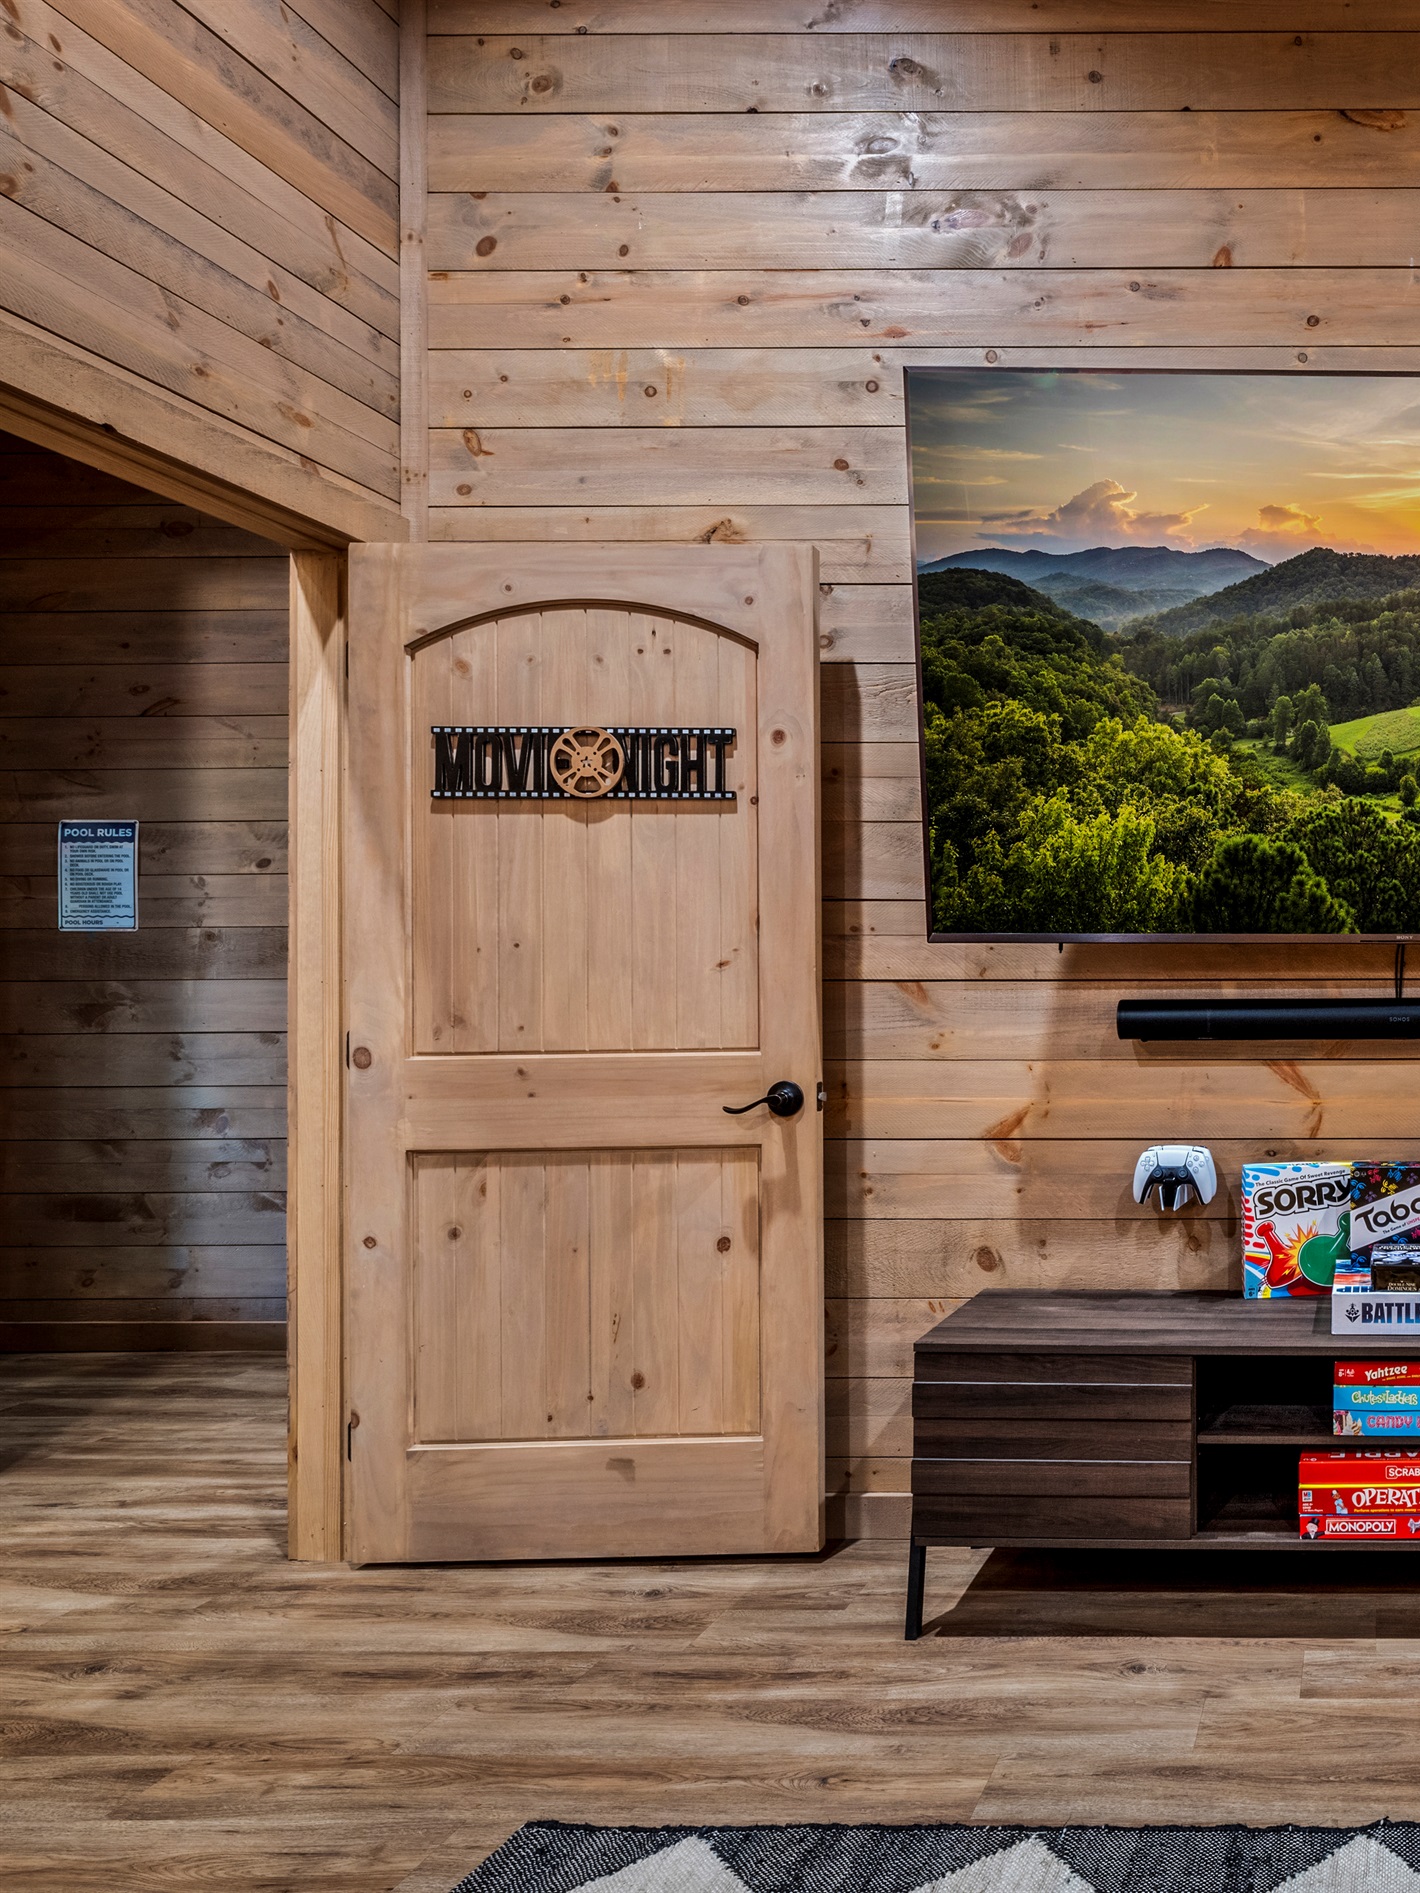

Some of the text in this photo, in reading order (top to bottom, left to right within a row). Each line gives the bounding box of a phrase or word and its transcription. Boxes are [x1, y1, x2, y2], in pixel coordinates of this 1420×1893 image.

[612, 732, 733, 792] NIGHT
[64, 828, 133, 837] POOL RULES
[1265, 1178, 1283, 1186] Classic
[1323, 1169, 1346, 1177] Revenge
[1364, 1365, 1408, 1381] Yahtzee
[1366, 1415, 1413, 1428] CANDY
[1329, 1521, 1394, 1532] MONOPOLY
